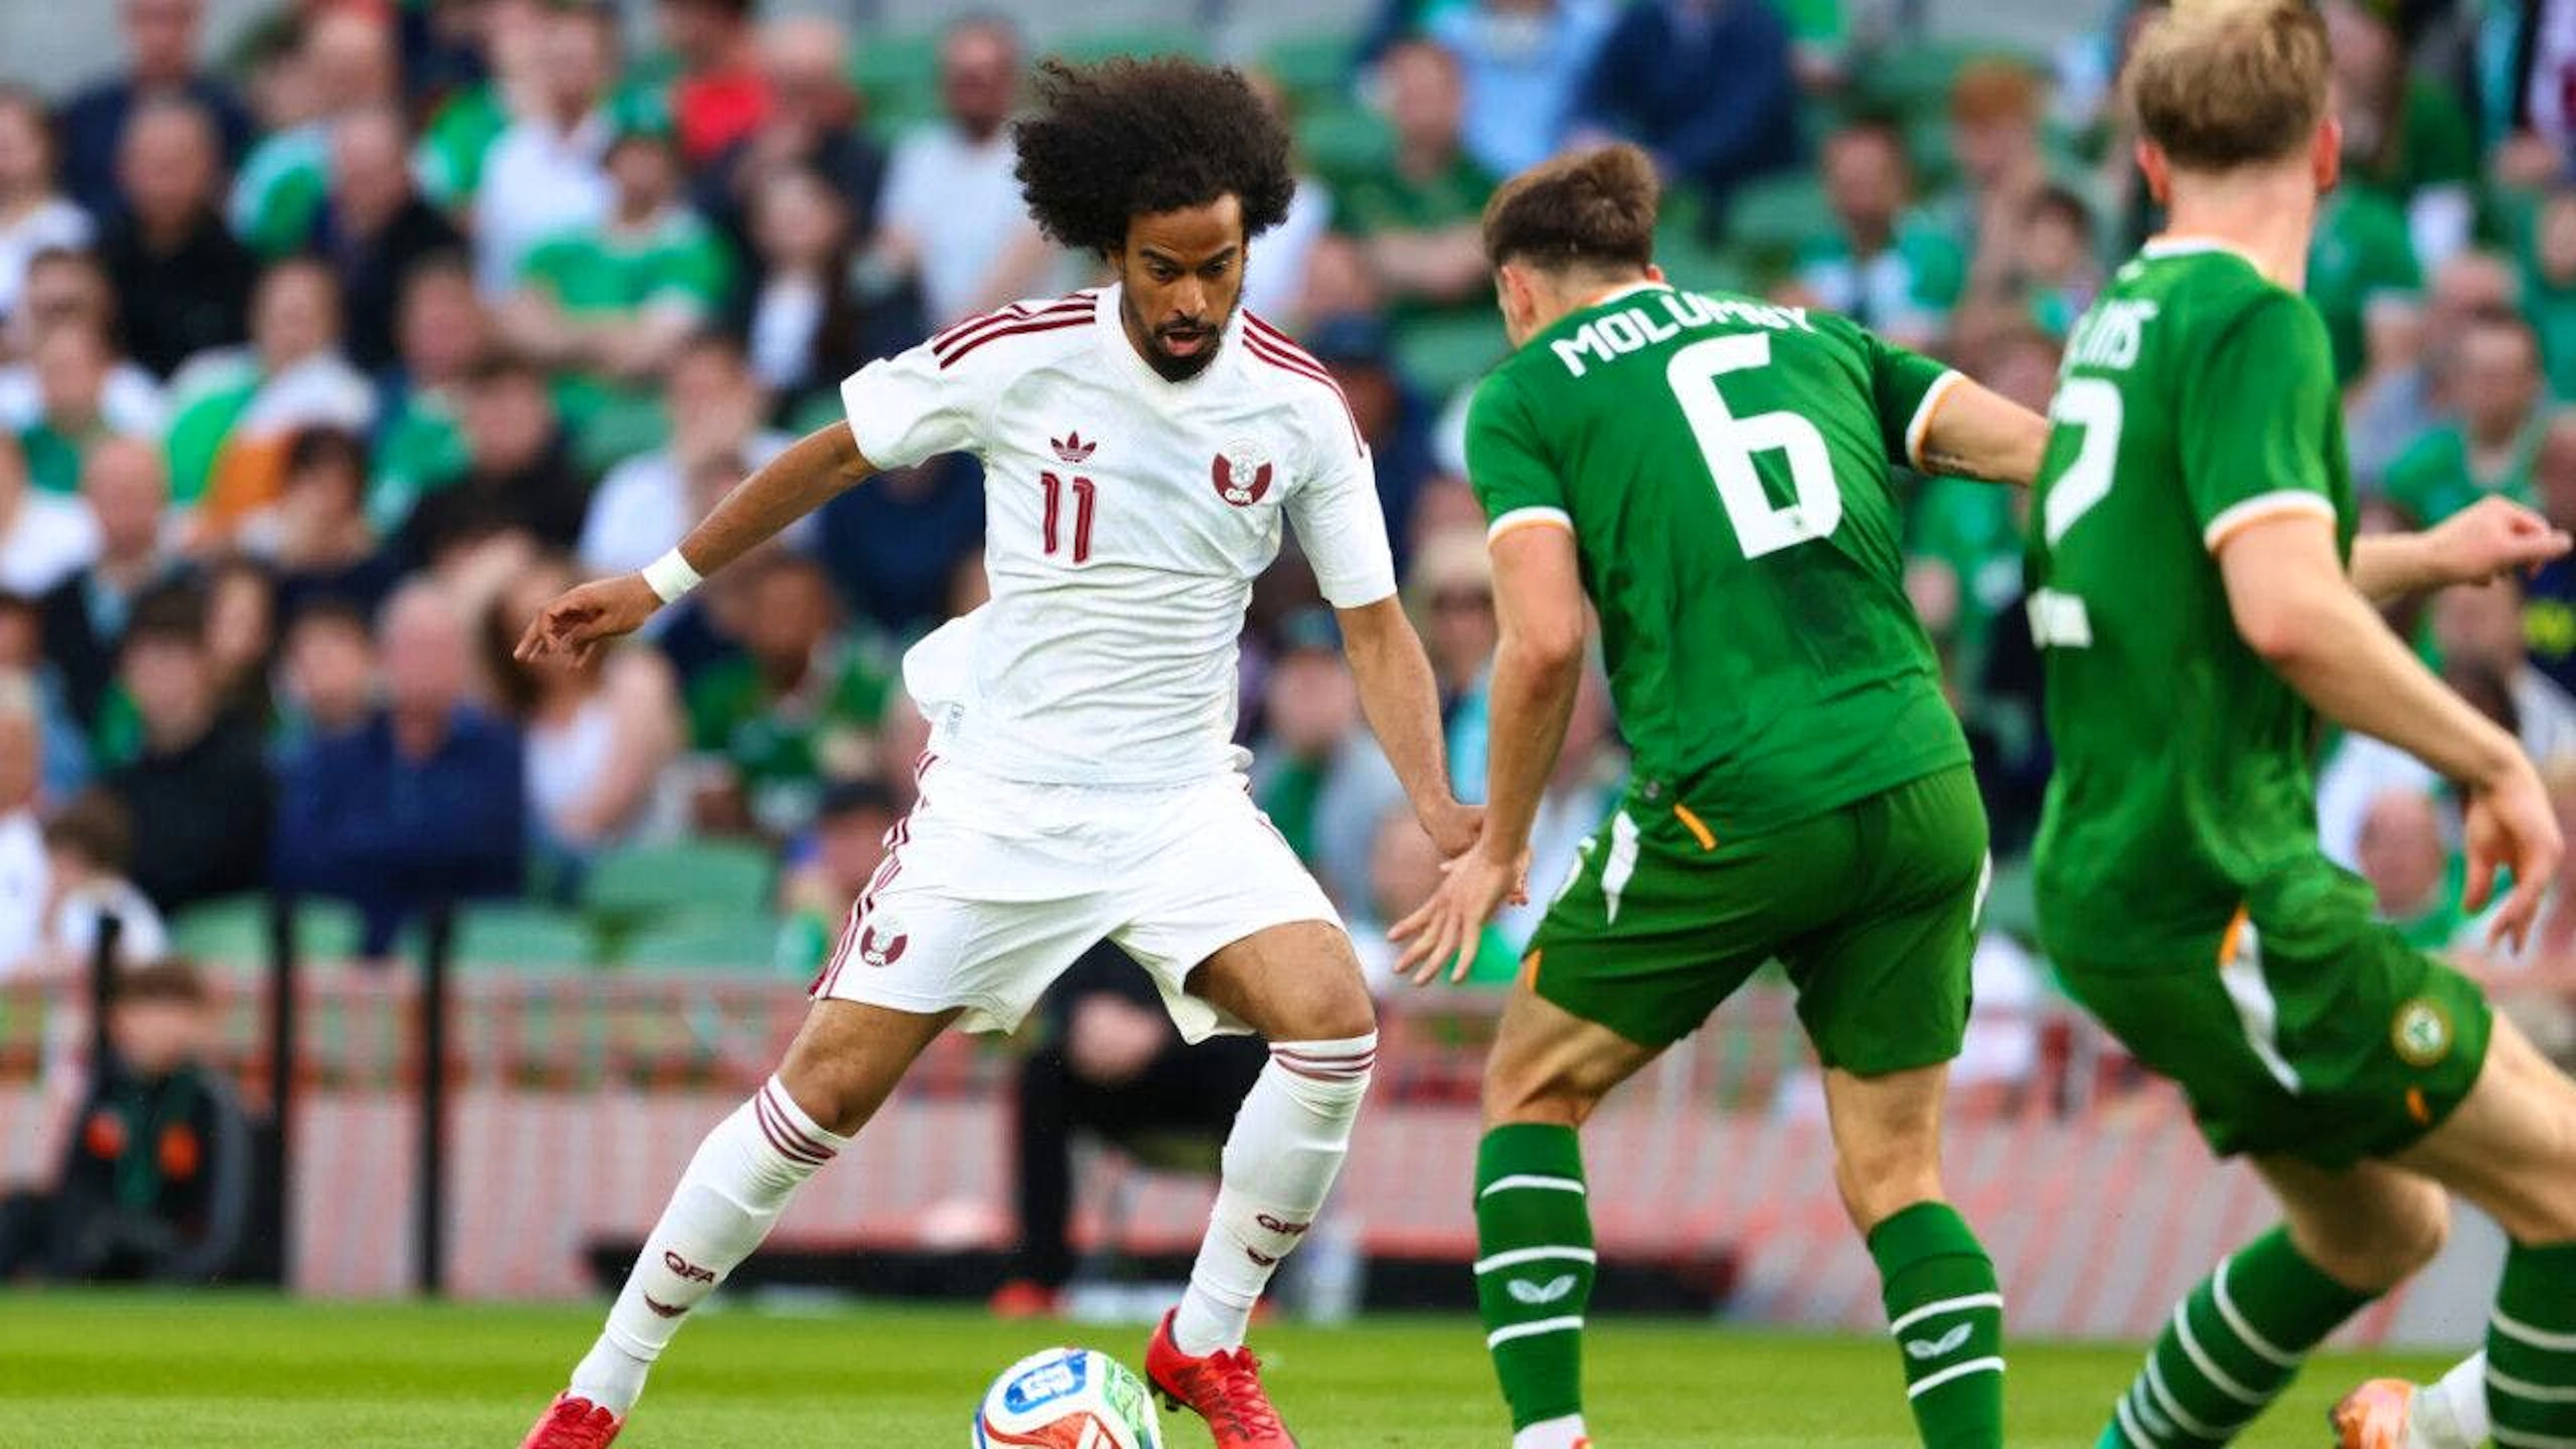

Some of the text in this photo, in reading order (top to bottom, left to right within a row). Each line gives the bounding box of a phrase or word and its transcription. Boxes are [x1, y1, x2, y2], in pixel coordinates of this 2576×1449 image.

[1666, 331, 1842, 559] 6
[1040, 472, 1096, 564] 11
[665, 1251, 716, 1283] QFA
